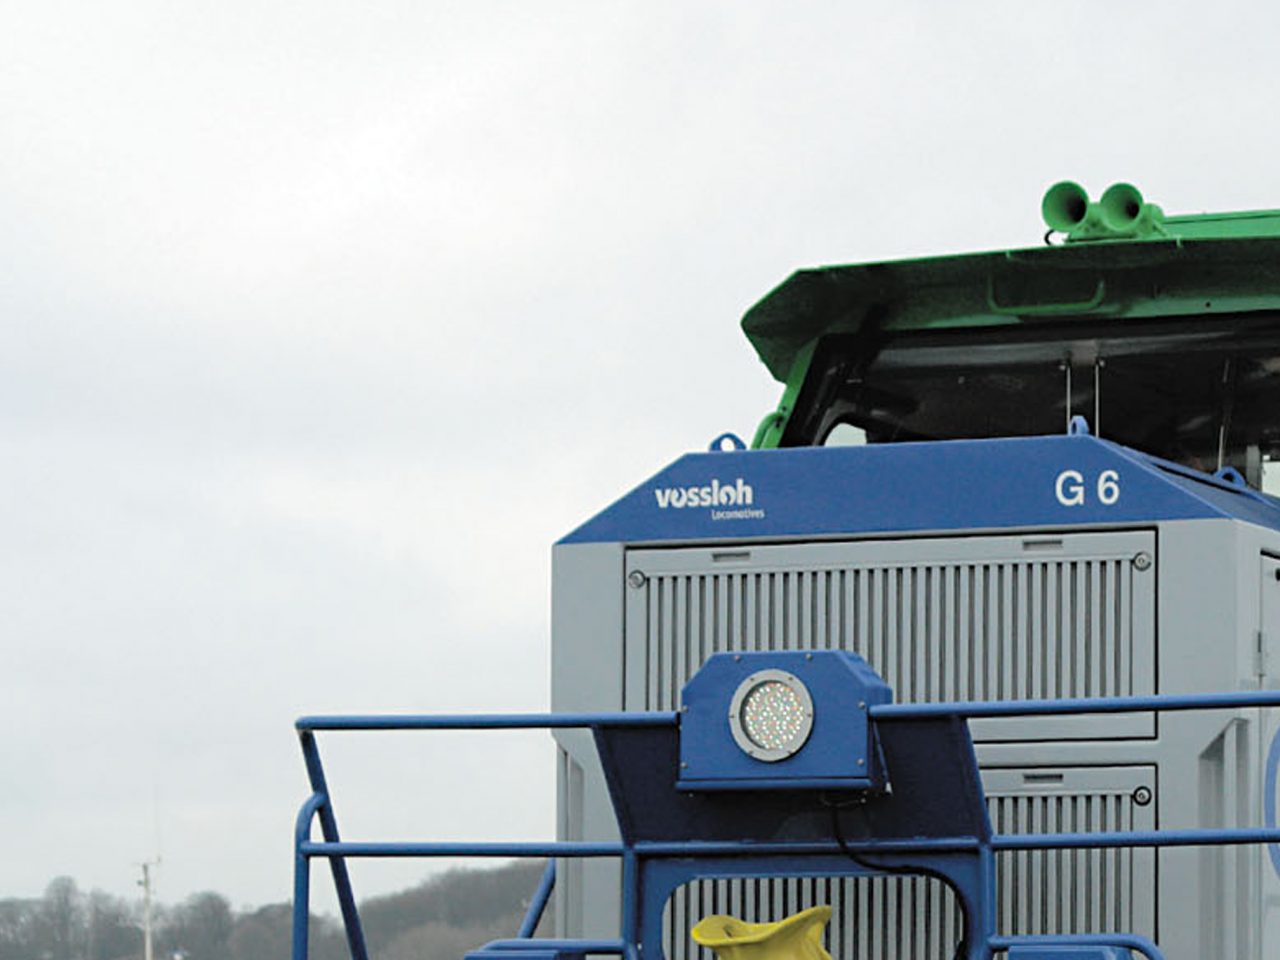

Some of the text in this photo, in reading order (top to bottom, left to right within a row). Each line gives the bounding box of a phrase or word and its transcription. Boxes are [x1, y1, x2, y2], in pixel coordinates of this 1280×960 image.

[655, 478, 753, 508] vossloh
[1055, 469, 1120, 507] G 6
[711, 508, 765, 520] Locomotives
